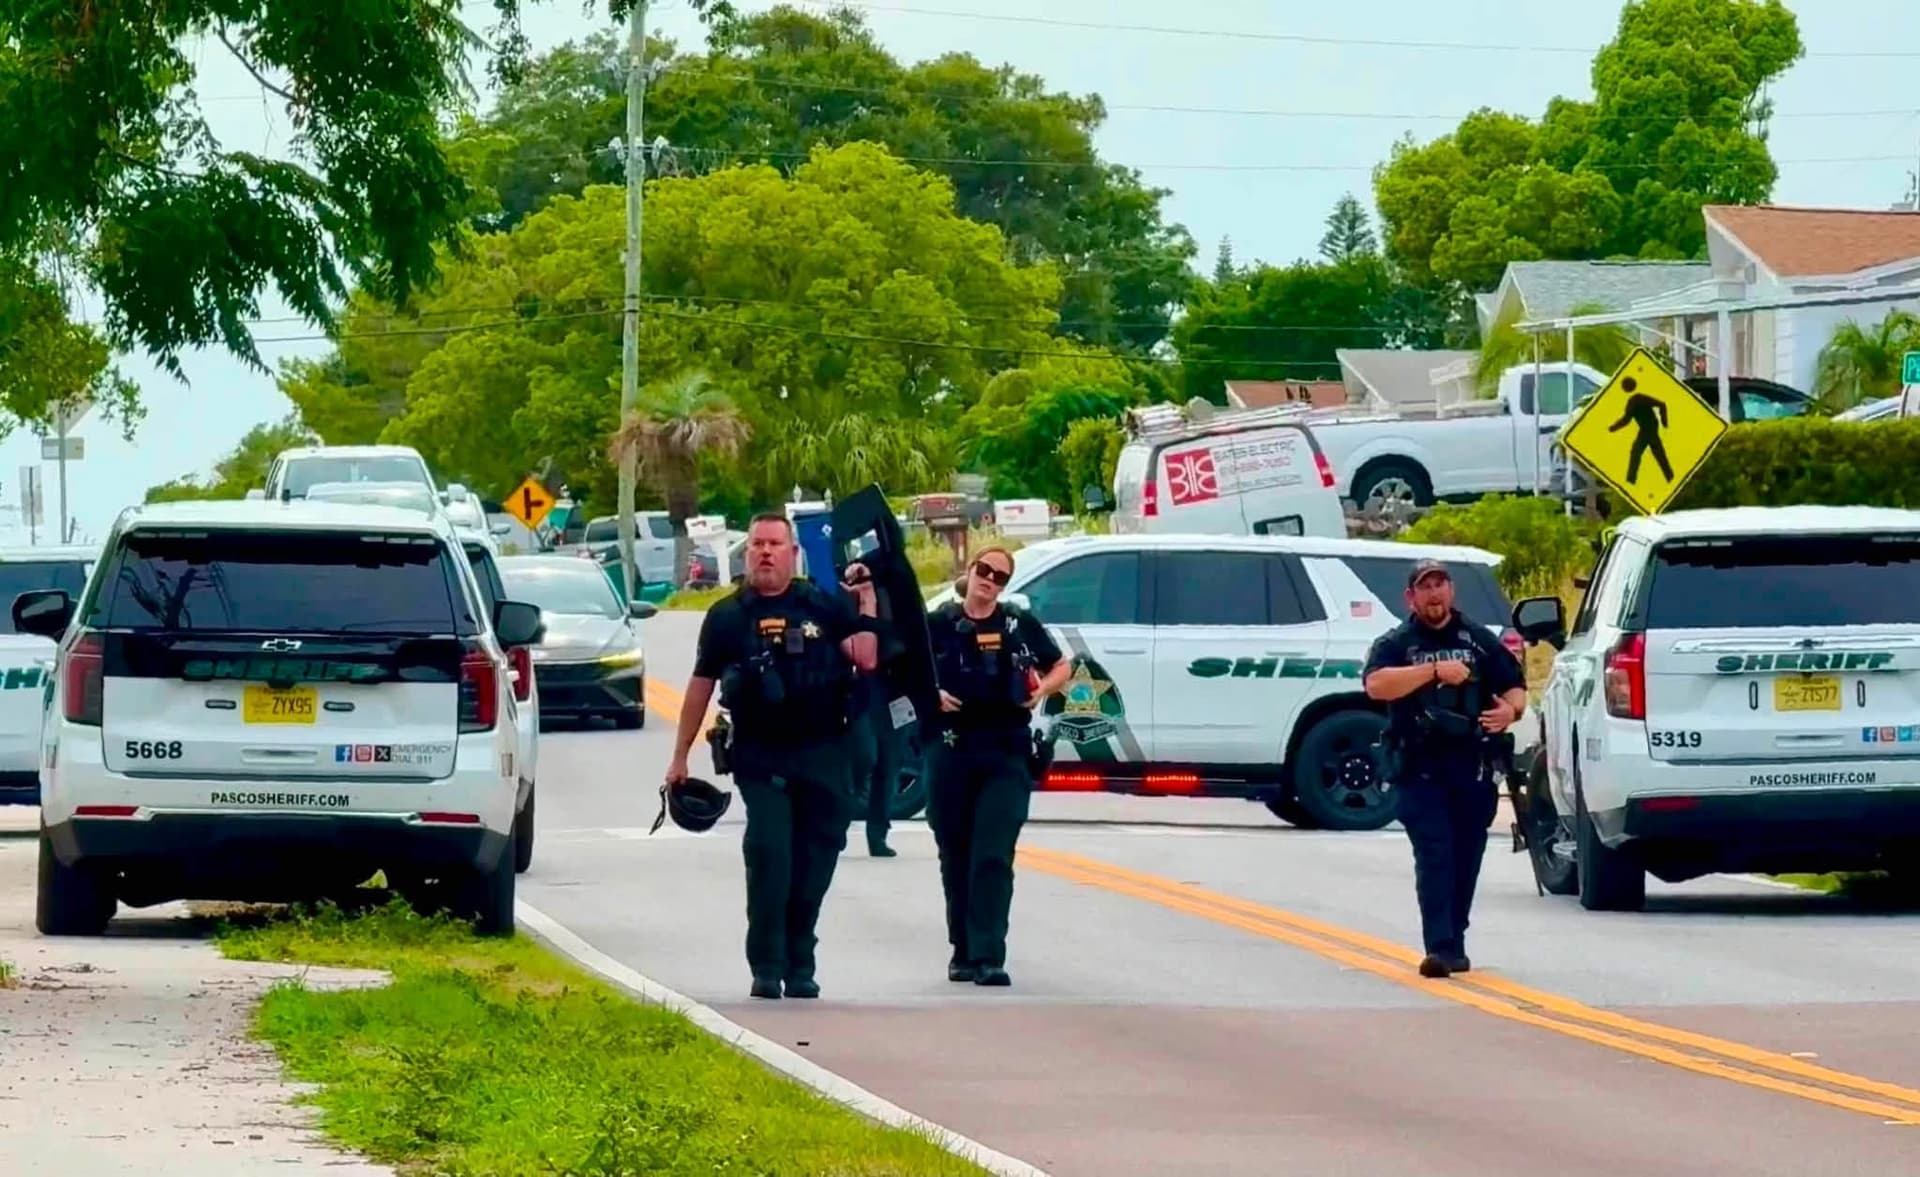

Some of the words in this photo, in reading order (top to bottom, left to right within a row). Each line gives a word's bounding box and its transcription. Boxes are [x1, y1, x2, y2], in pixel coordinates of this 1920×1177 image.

[1715, 653, 1894, 672] SHERIFF
[1651, 731, 1702, 748] 5319
[125, 741, 183, 759] 5668
[1750, 772, 1876, 786] PASCOSHERIFF.COM
[211, 792, 349, 807] PASCOSHERIFF.COM
